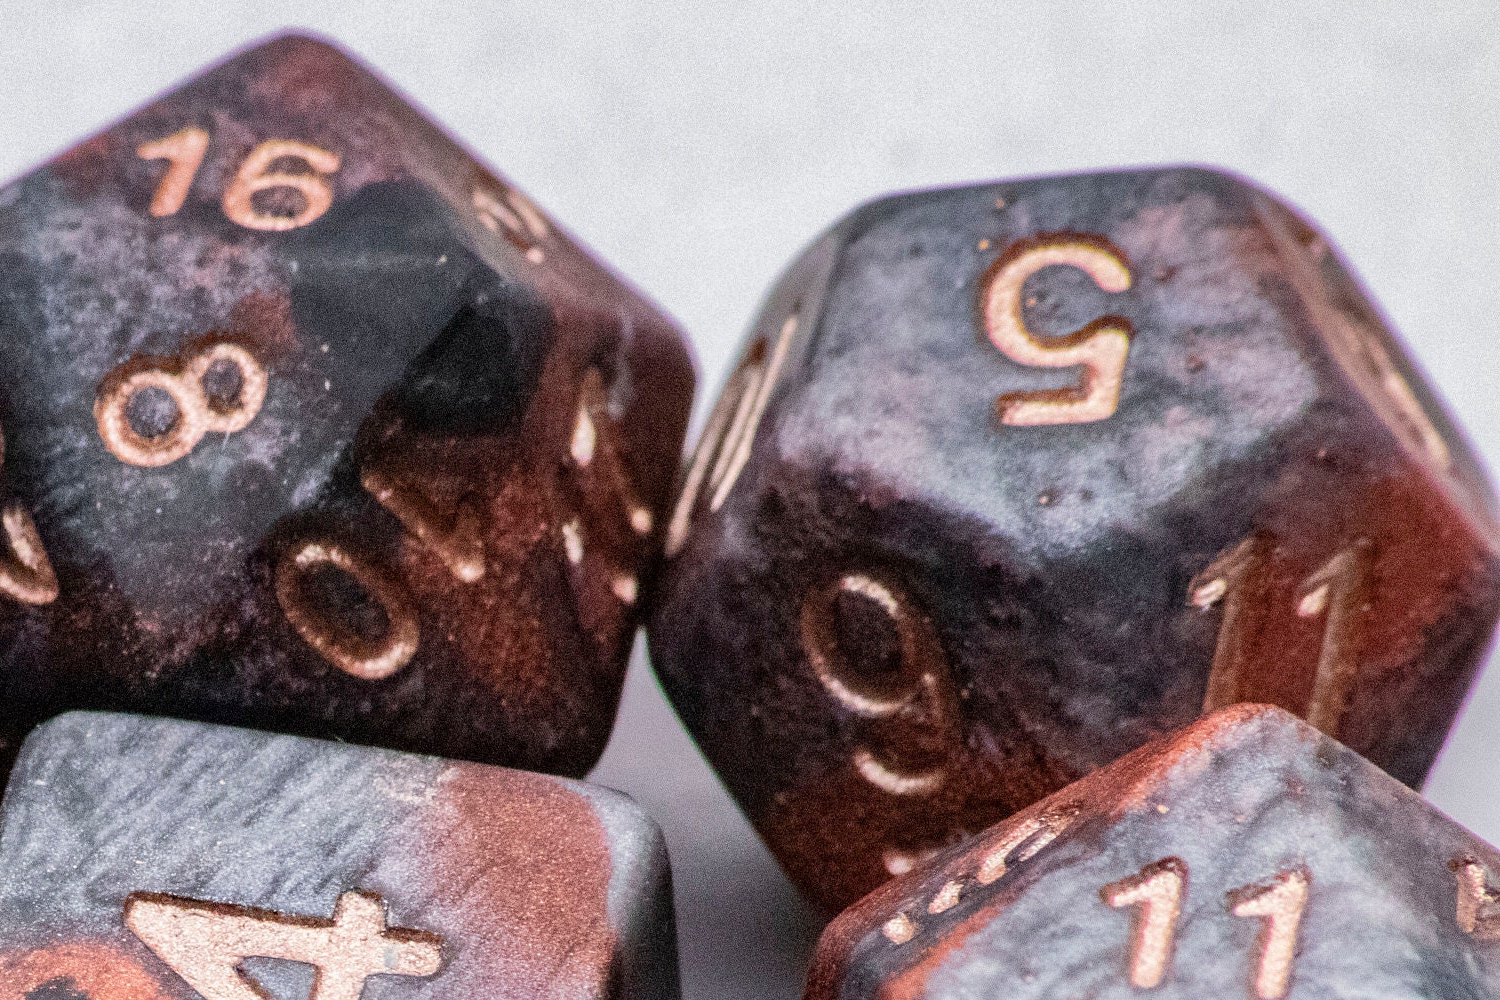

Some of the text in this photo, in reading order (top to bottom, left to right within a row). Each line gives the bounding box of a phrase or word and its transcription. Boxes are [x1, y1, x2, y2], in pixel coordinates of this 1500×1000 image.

[137, 125, 342, 232] 16
[94, 340, 268, 467] 8
[980, 236, 1133, 426] 5
[276, 468, 486, 680] 10
